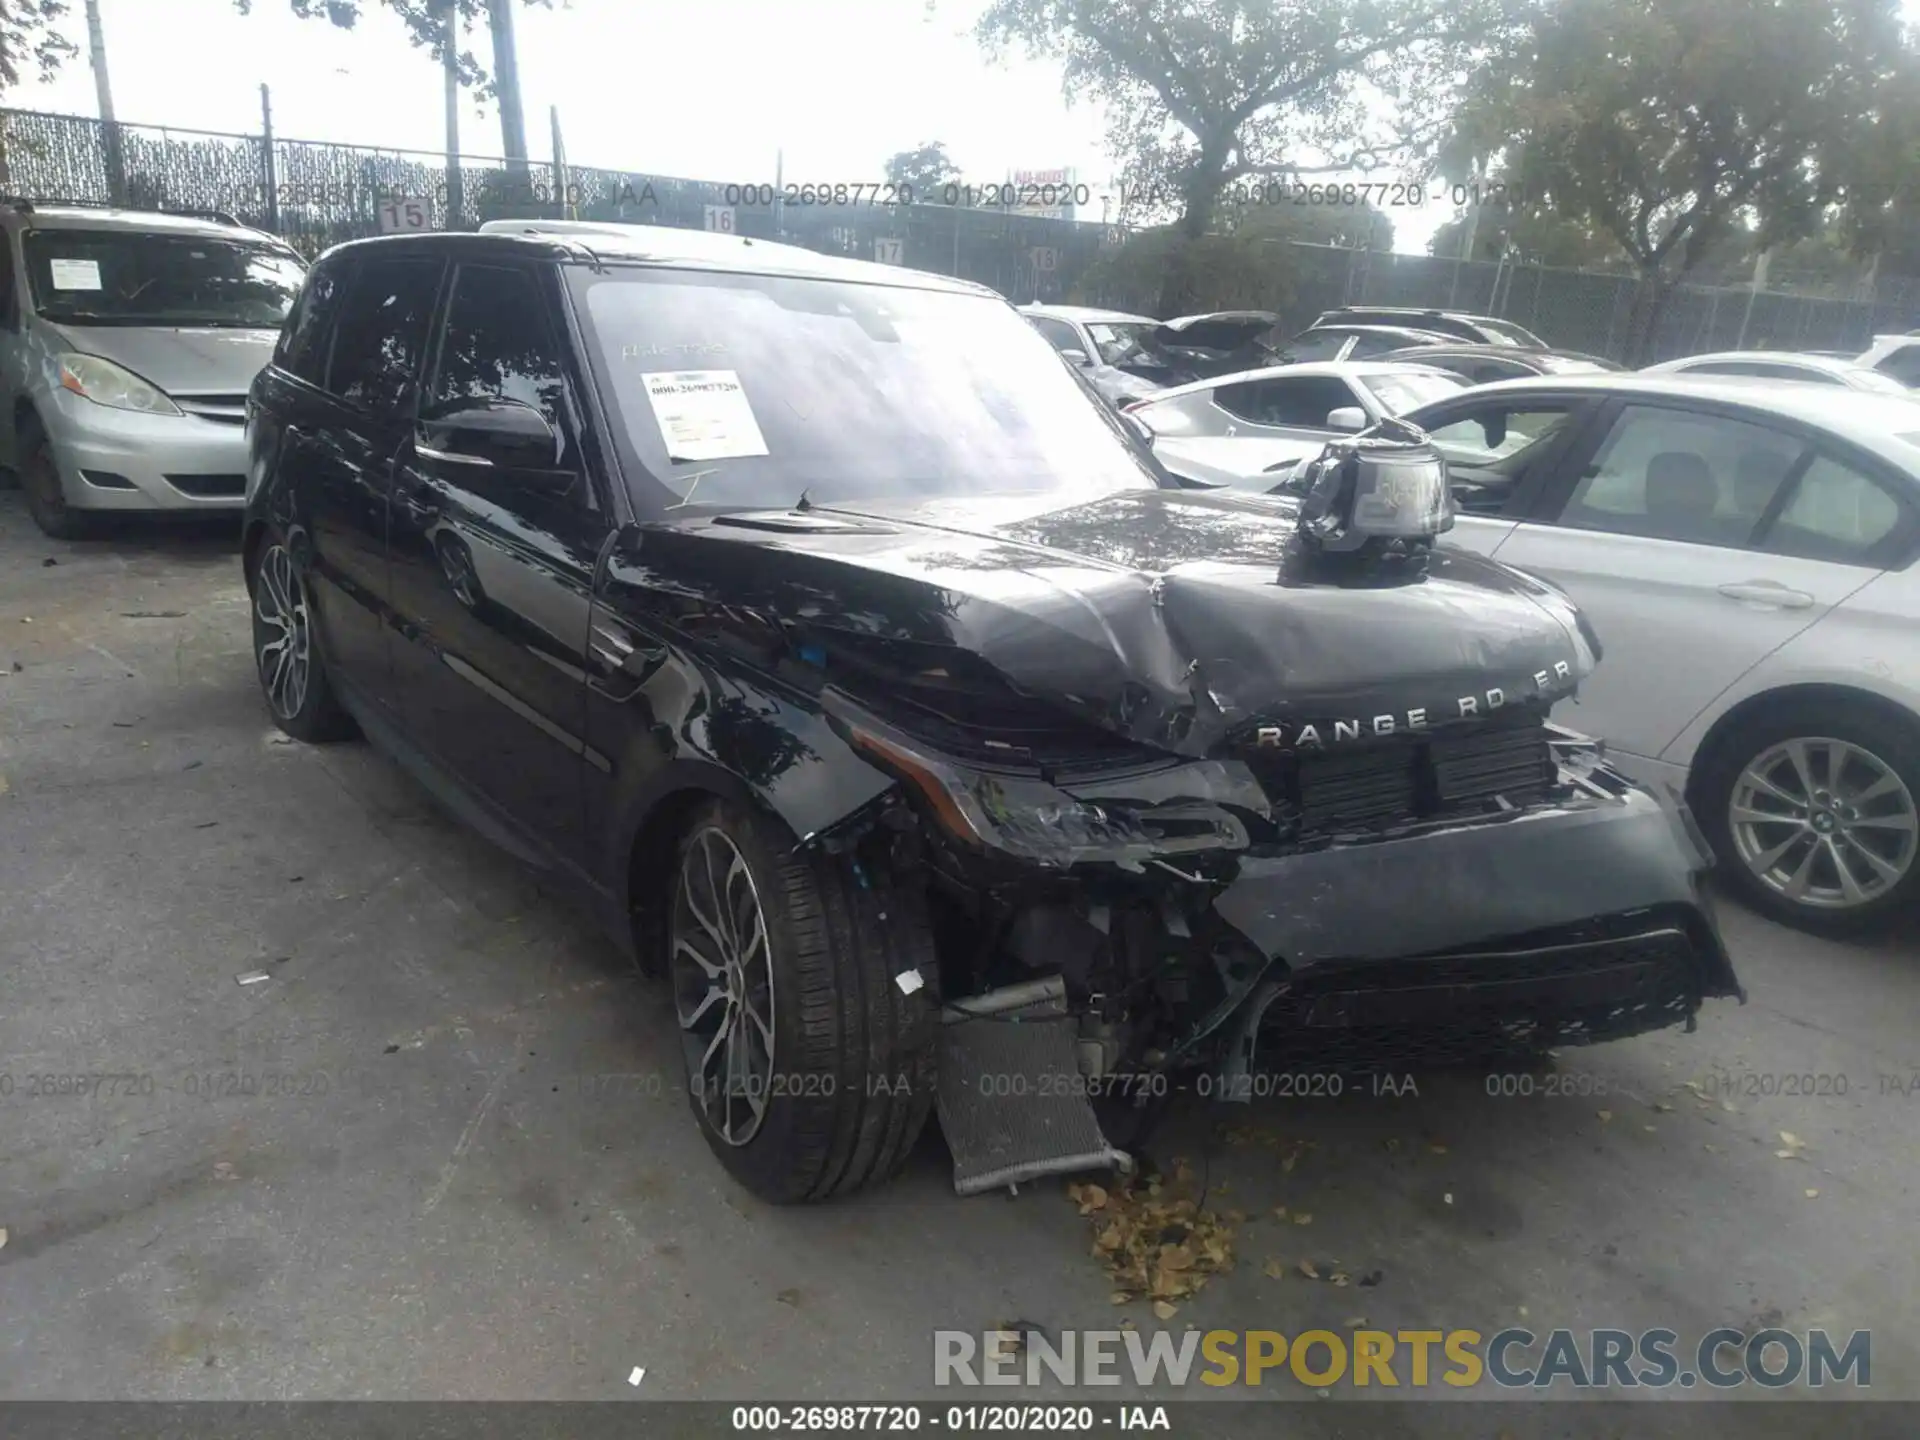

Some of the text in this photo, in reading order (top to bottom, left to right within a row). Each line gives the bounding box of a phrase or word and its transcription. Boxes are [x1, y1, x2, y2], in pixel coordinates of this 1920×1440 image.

[384, 204, 423, 228] 15
[707, 210, 731, 232] 16
[878, 242, 900, 262] 17
[1257, 707, 1427, 747] RANGE
